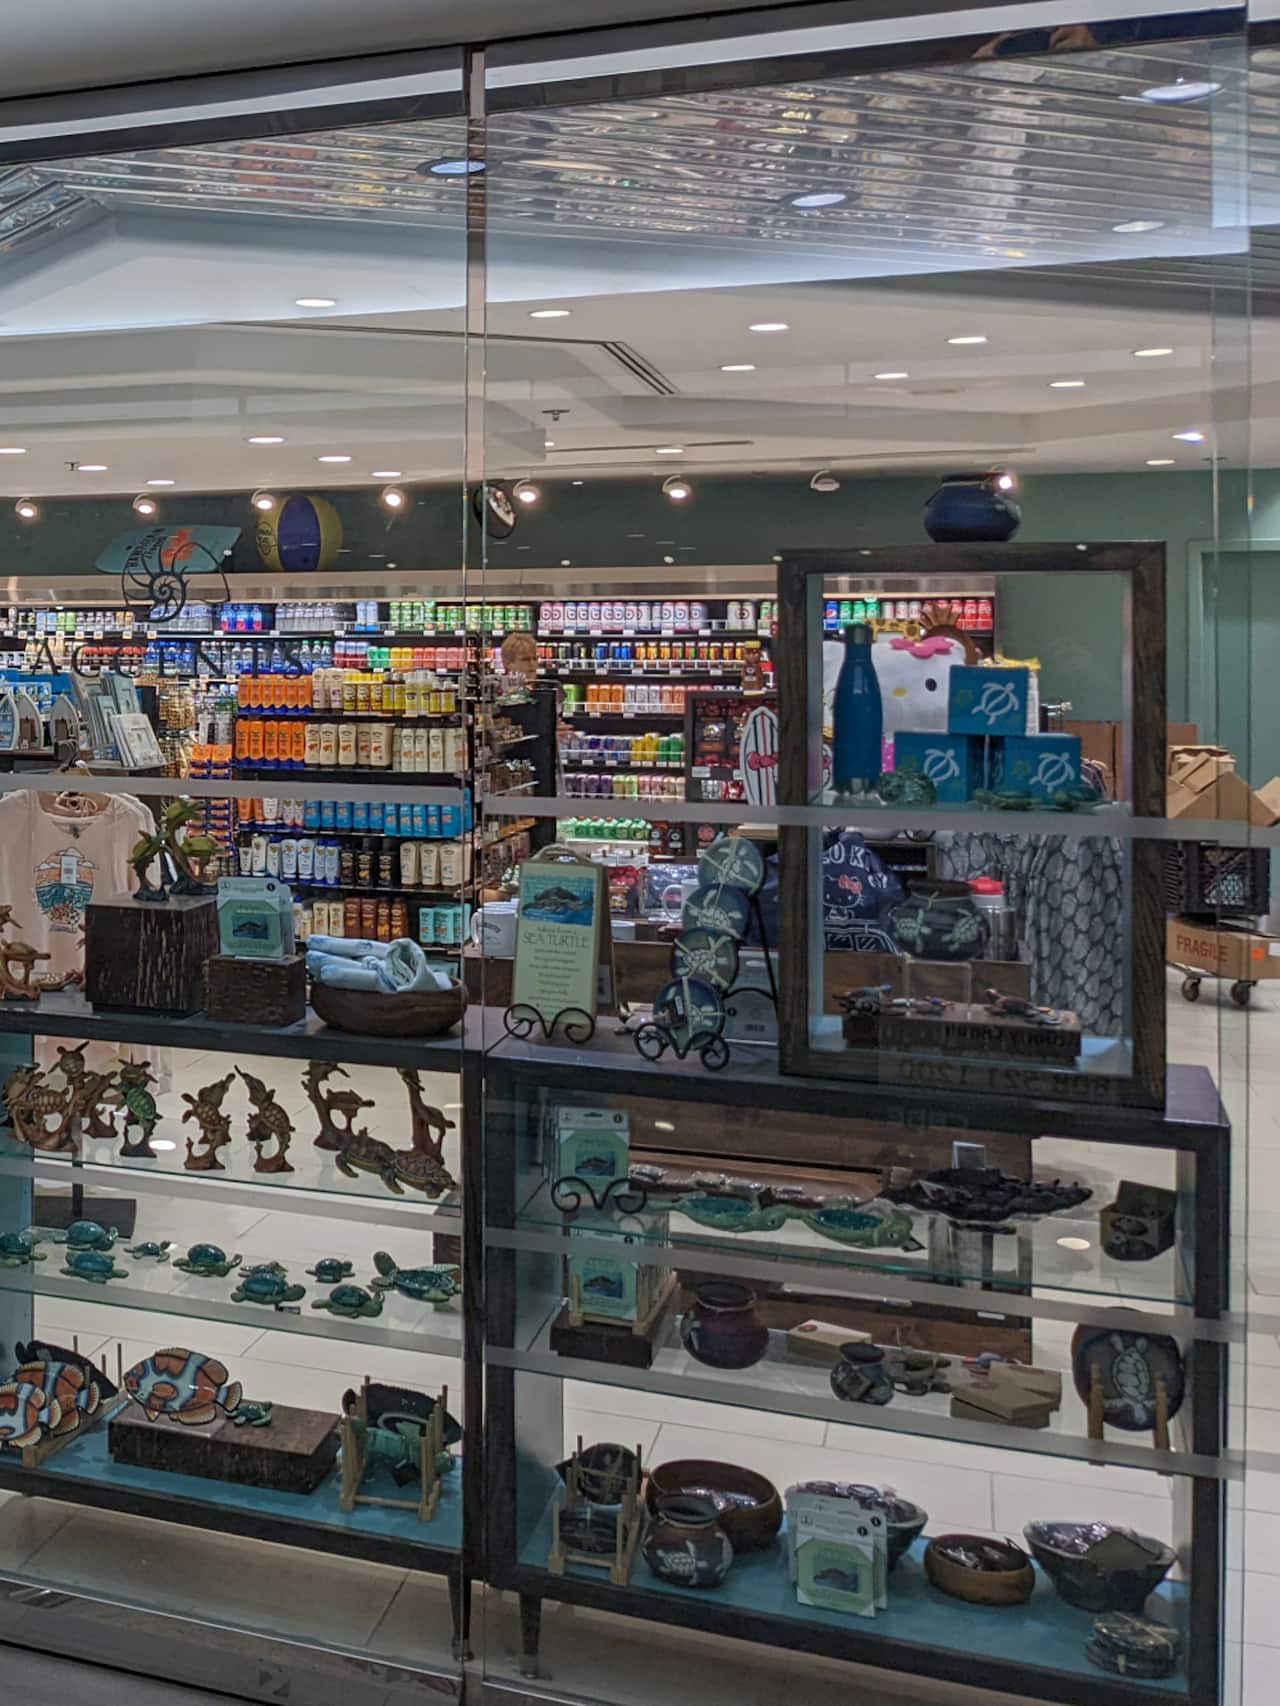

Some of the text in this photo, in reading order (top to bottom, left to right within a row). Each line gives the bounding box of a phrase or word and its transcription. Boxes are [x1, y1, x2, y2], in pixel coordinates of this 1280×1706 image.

[31, 638, 305, 680] ACCENTS
[523, 930, 589, 948] SEA TURTLE
[1176, 935, 1228, 962] FRAGILE
